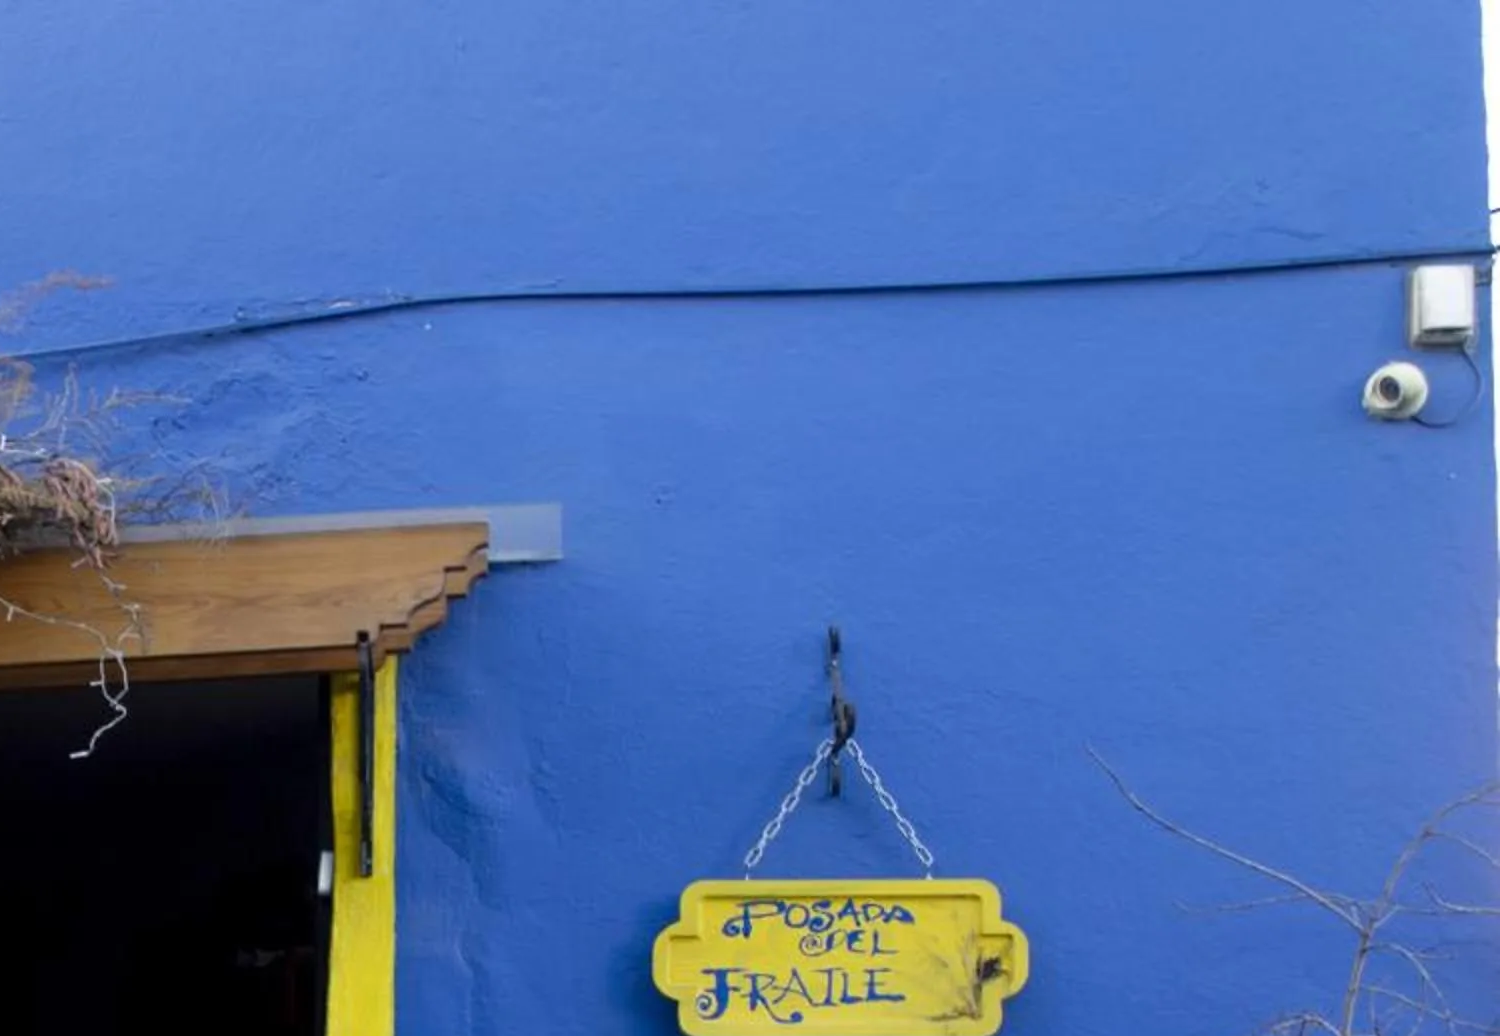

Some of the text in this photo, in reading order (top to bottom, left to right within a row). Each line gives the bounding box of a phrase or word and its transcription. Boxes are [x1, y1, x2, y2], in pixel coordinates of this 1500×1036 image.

[722, 899, 914, 938] POSADA
[799, 930, 900, 957] DEL
[696, 968, 905, 1024] FRAILE
